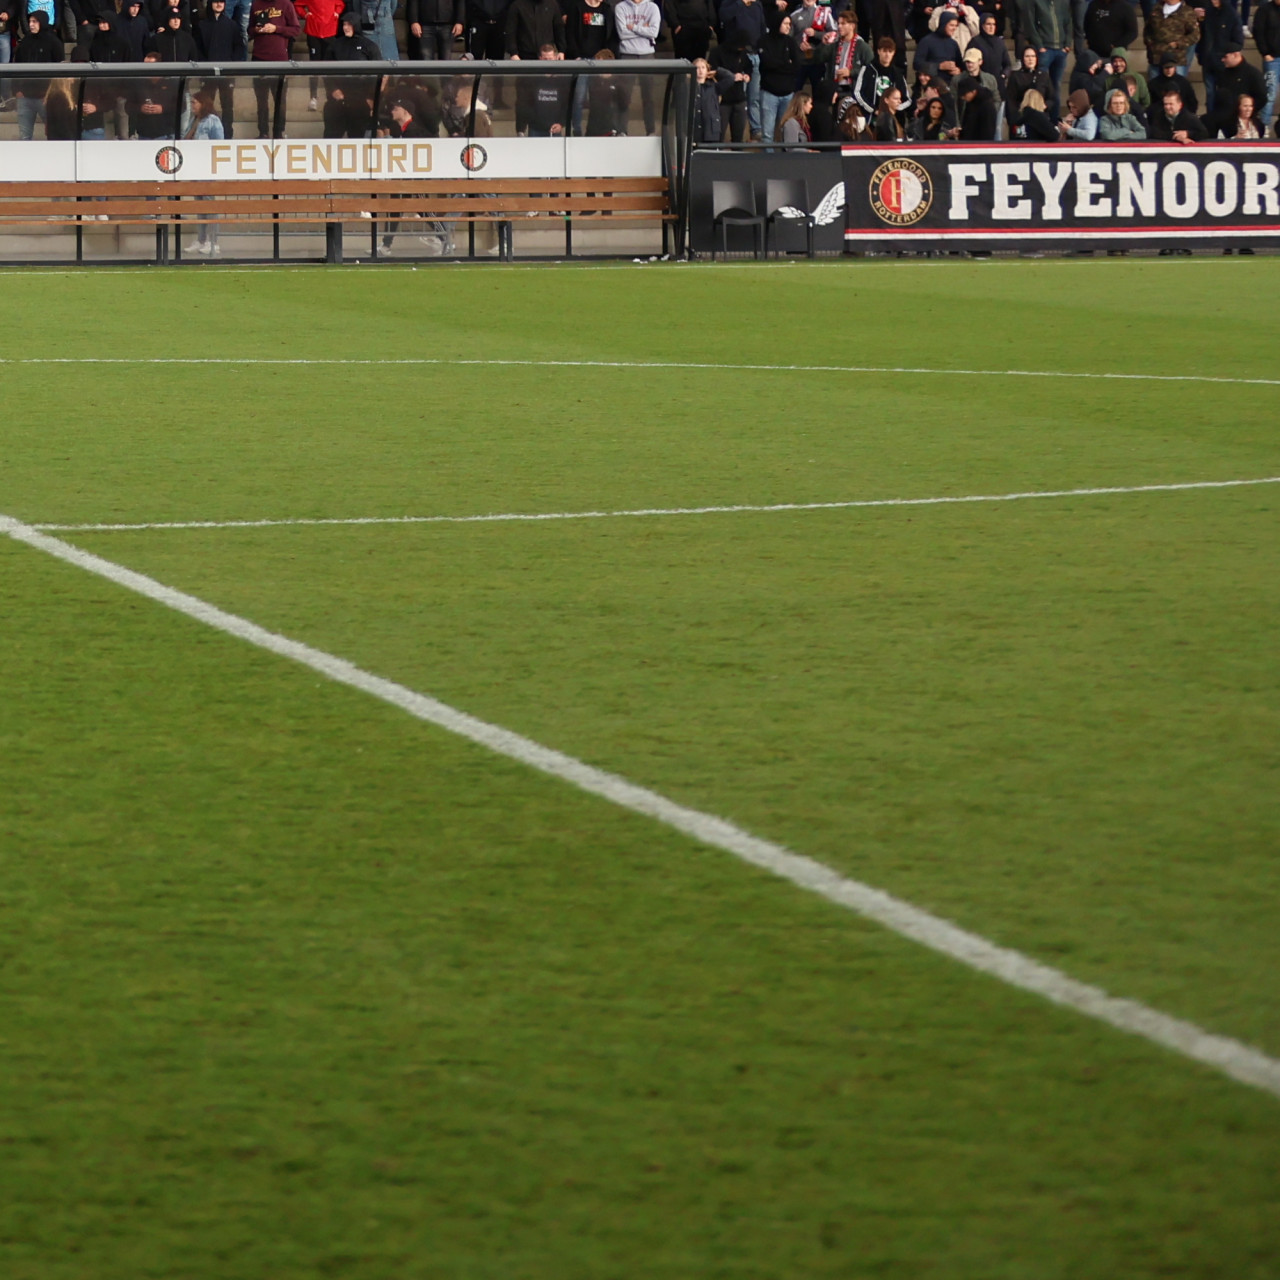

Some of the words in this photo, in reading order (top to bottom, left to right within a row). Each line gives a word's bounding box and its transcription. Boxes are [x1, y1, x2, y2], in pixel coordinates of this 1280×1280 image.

[211, 144, 432, 174] FEYENOORD
[874, 161, 927, 184] FEYENOORD
[874, 200, 927, 223] ROTTERDAM
